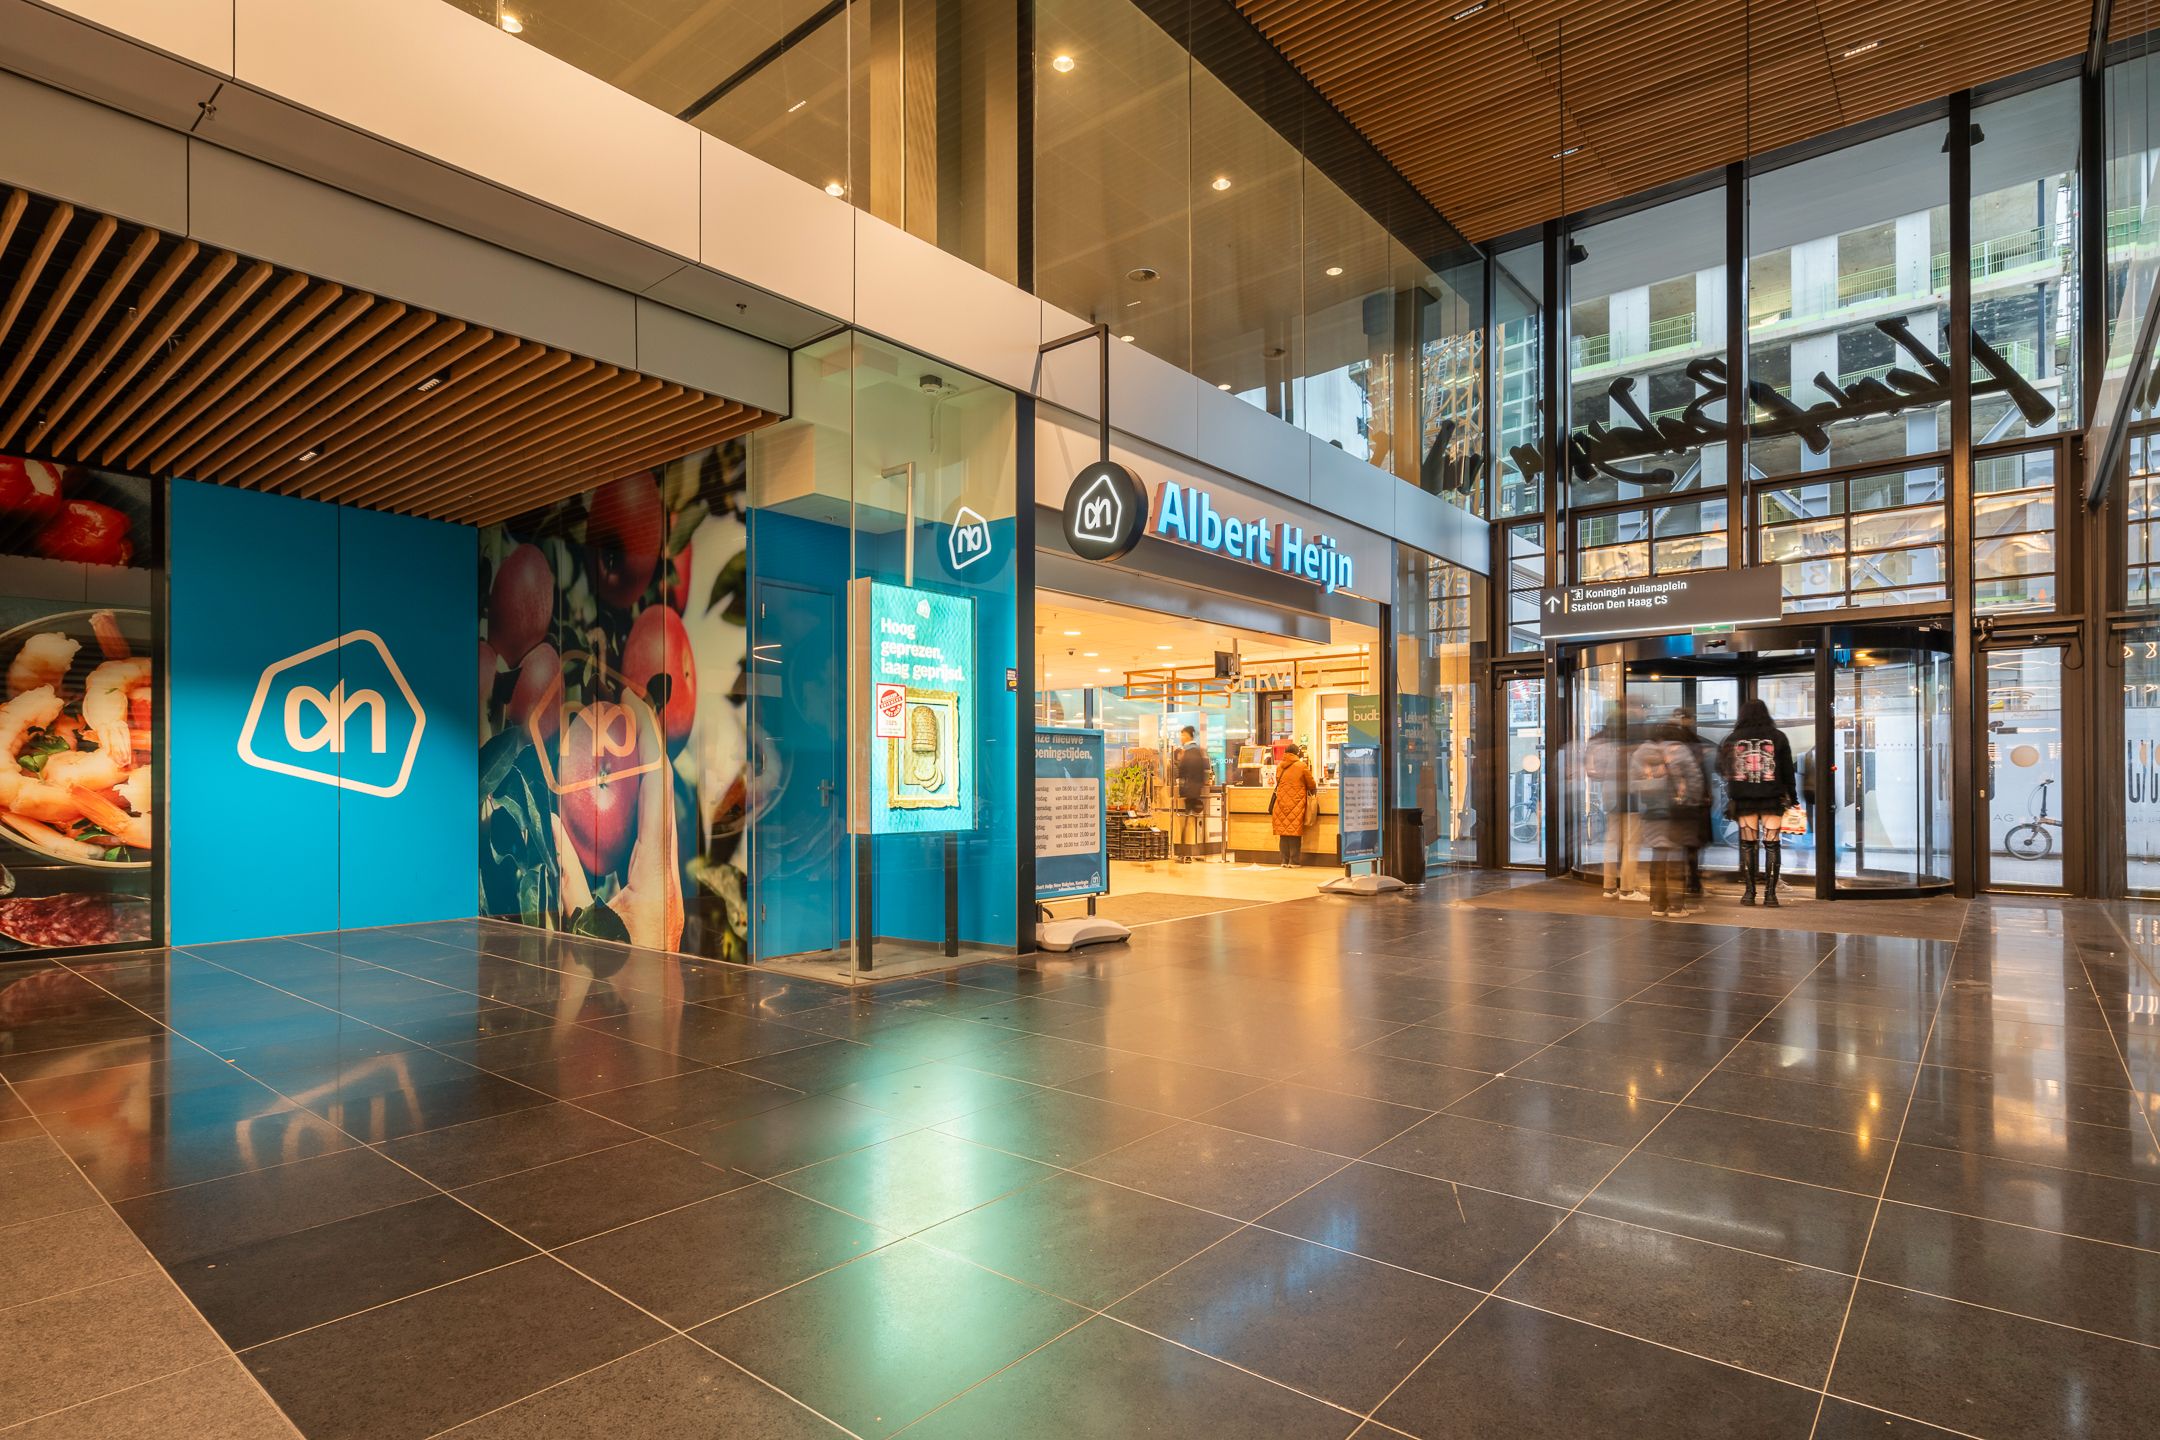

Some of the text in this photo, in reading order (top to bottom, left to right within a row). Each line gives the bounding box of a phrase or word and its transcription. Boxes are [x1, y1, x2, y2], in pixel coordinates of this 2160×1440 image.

[1157, 480, 1354, 594] Albert Heijn
[1585, 581, 1687, 598] Koningin Julianaplein
[1571, 595, 1668, 612] Station Den Haag CS
[881, 616, 916, 639] Hoog
[881, 640, 945, 662] geprezen,
[881, 658, 965, 683] laag geprijsd.
[1035, 734, 1084, 744] nze nieuwe
[1035, 746, 1093, 761] eningstijden.
[1992, 813, 2015, 823] AG
